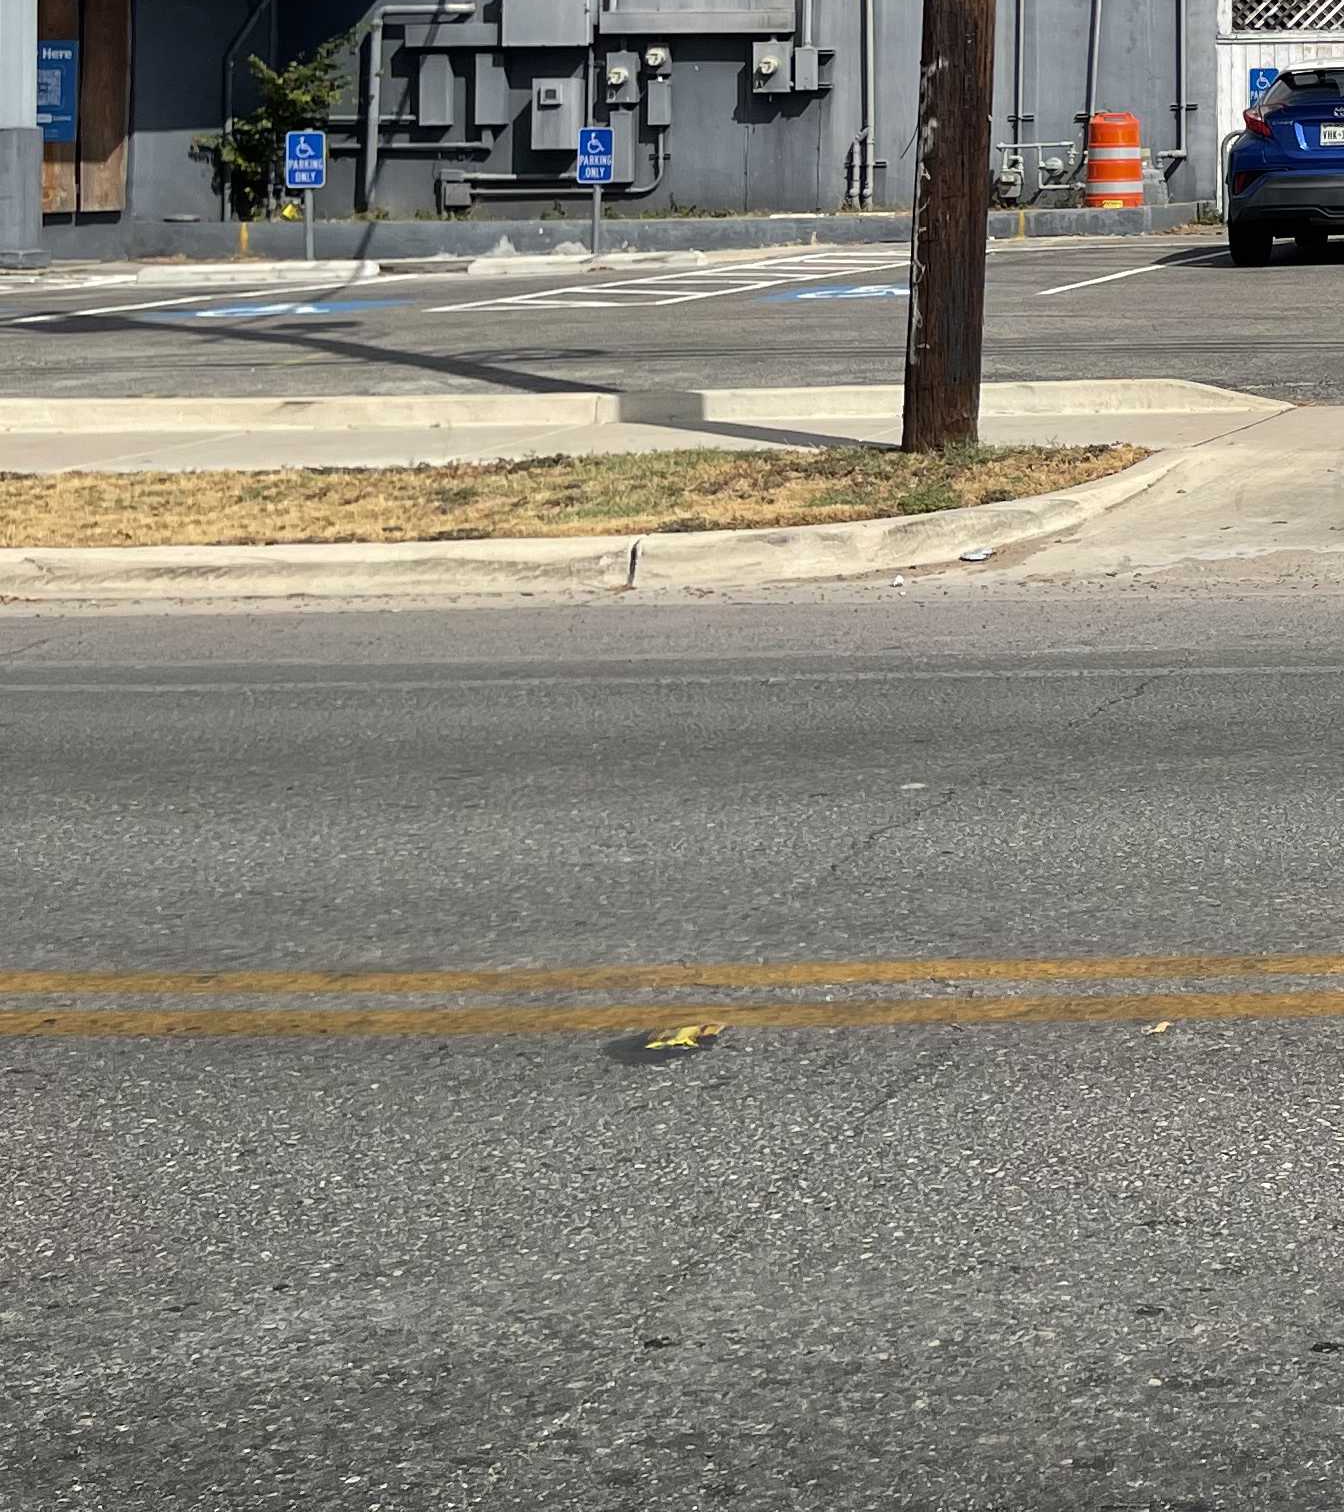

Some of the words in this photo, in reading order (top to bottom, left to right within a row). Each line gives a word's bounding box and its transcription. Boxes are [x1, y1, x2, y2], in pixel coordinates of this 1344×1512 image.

[42, 47, 73, 60] Here
[288, 159, 324, 170] PARKING
[580, 155, 612, 166] PARKING
[295, 171, 316, 183] ONLY
[585, 167, 606, 178] ONLY
